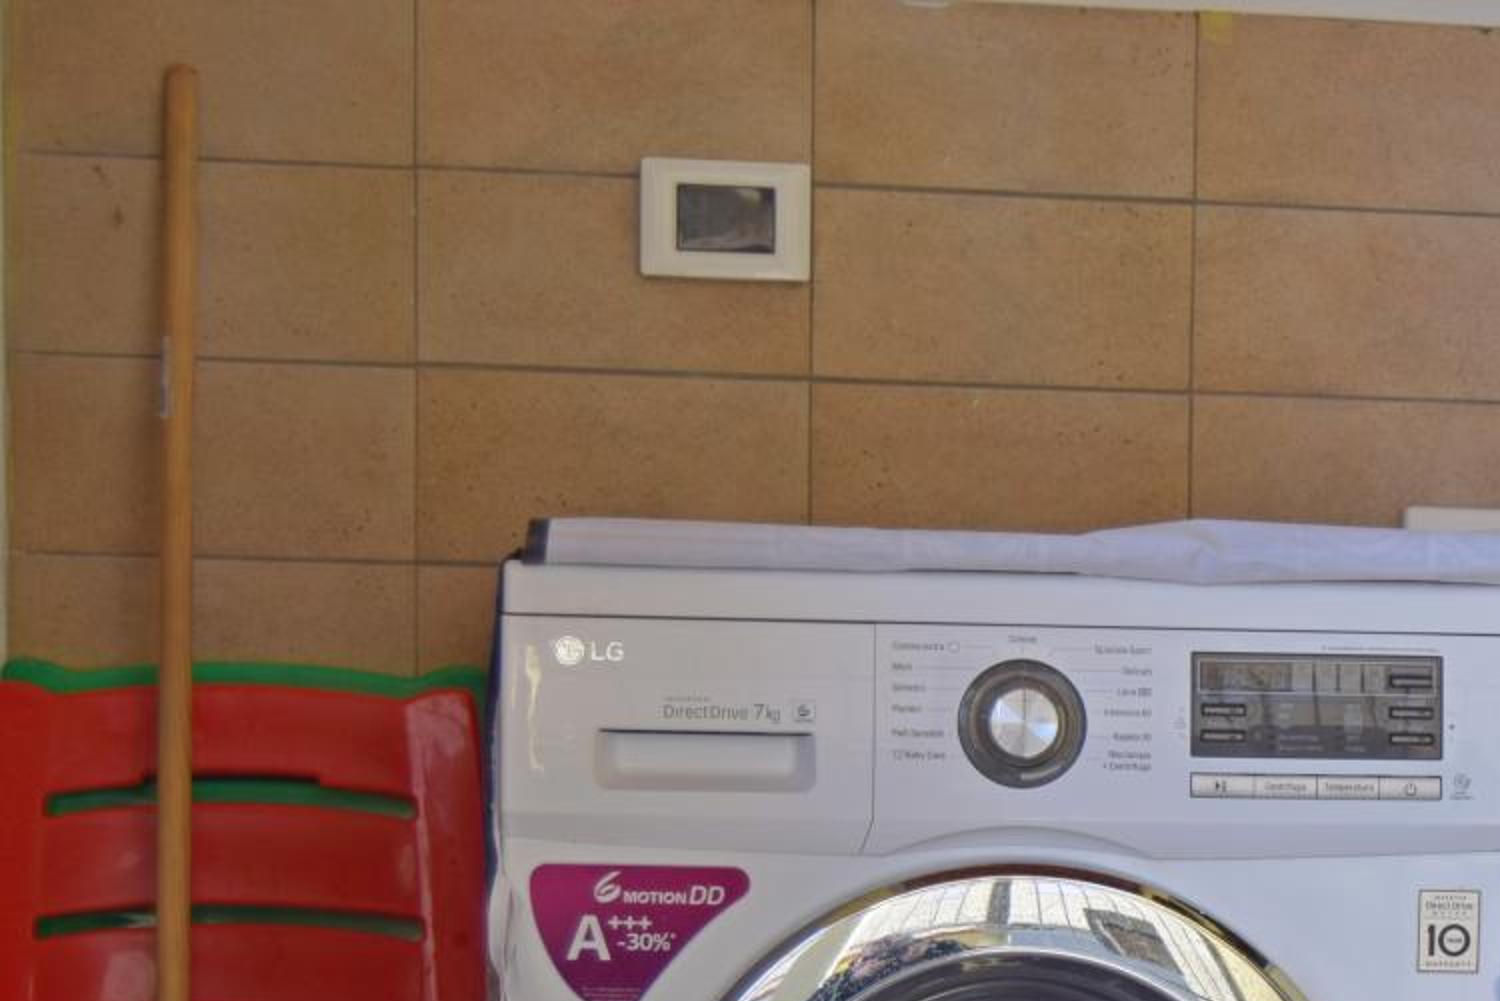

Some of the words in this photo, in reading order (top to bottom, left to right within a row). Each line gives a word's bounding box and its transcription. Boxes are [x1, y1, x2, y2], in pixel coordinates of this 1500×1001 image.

[590, 641, 625, 661] LG
[623, 889, 688, 906] MOTION
[1427, 923, 1471, 957] 10
